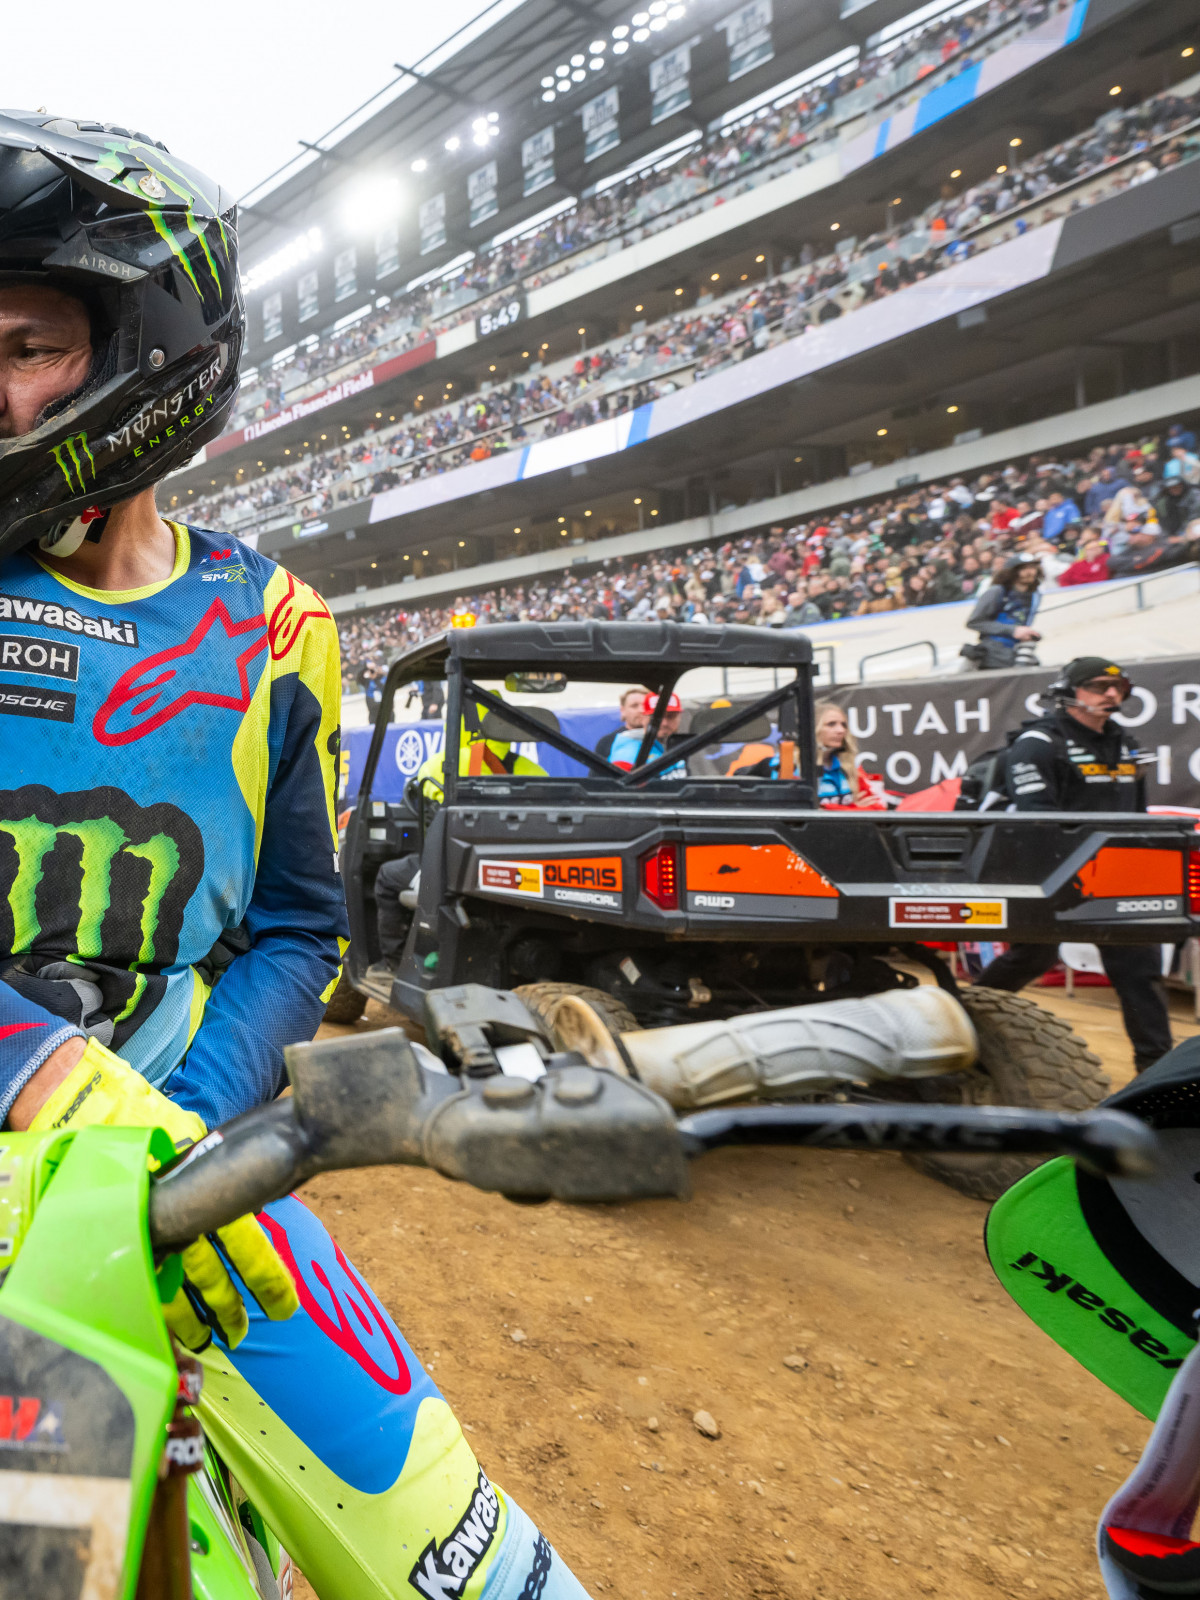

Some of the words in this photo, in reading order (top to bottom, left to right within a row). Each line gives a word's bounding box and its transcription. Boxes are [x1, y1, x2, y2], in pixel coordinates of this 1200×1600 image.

[79, 254, 131, 278] AIROH
[479, 302, 521, 336] 5:49
[292, 384, 343, 420] Financial
[342, 369, 375, 398] Field
[134, 393, 215, 458] ENERGY
[201, 567, 248, 584] SMX
[848, 698, 991, 739] UTAH
[694, 895, 735, 908] AWD
